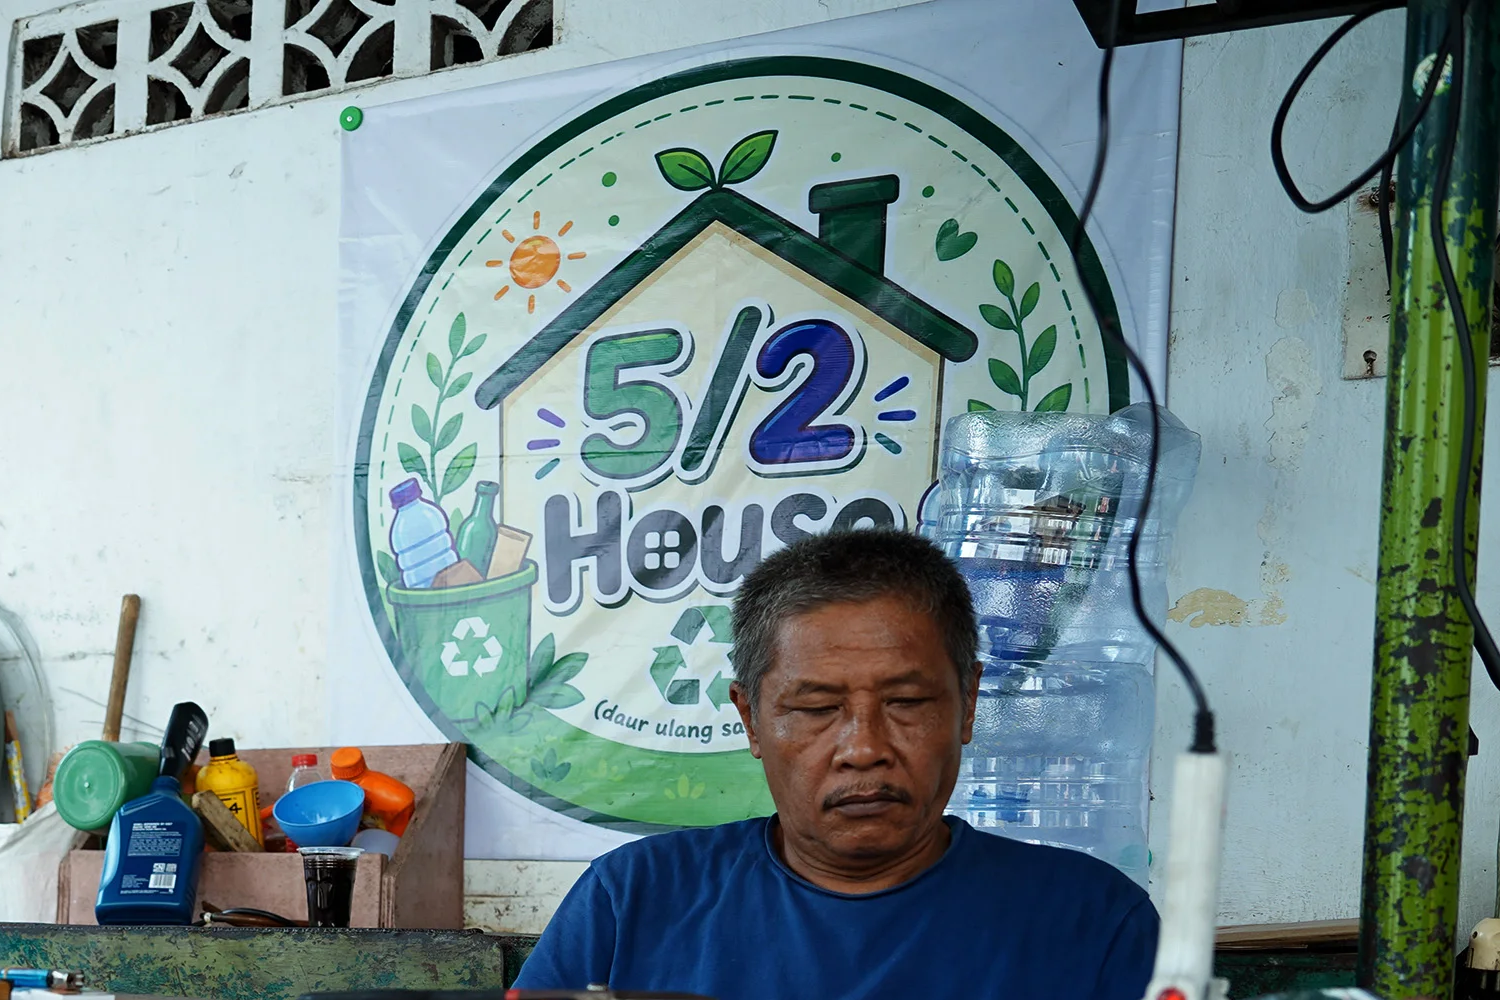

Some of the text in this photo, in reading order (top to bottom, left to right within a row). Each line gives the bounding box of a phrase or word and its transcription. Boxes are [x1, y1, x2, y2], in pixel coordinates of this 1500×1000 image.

[578, 304, 858, 481] 5/2
[594, 699, 746, 744] (daur ulang sa
